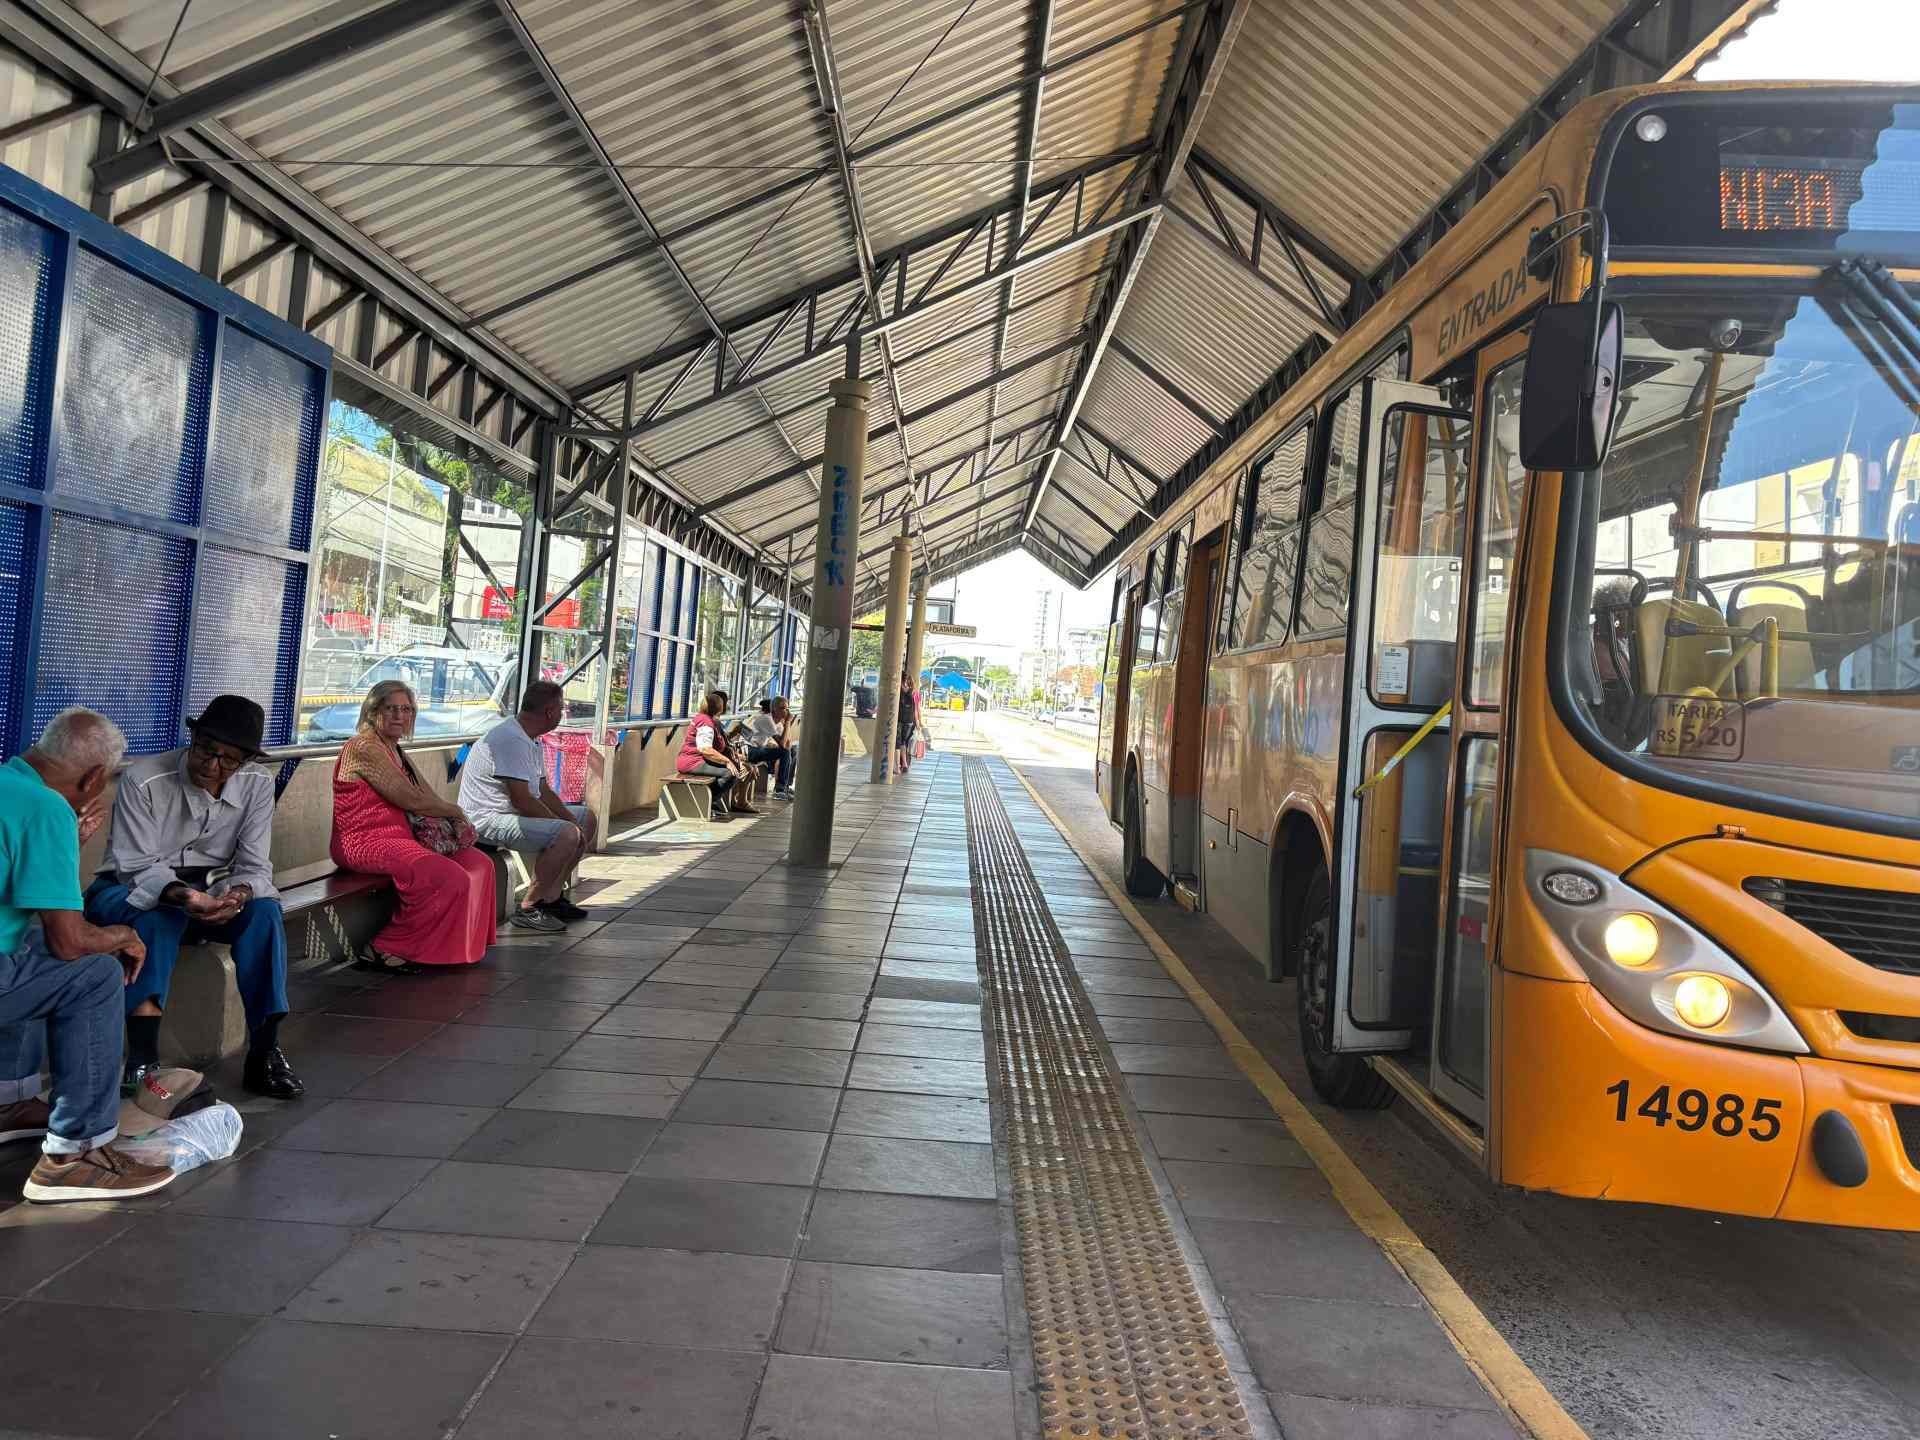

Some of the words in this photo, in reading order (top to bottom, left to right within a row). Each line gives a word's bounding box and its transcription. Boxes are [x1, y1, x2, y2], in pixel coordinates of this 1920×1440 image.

[1438, 256, 1528, 356] ENTRADA
[1670, 703, 1727, 721] TARIFA
[1656, 729, 1678, 745] R$
[1681, 725, 1737, 748] 5,20
[1606, 1079, 1783, 1142] 14985
